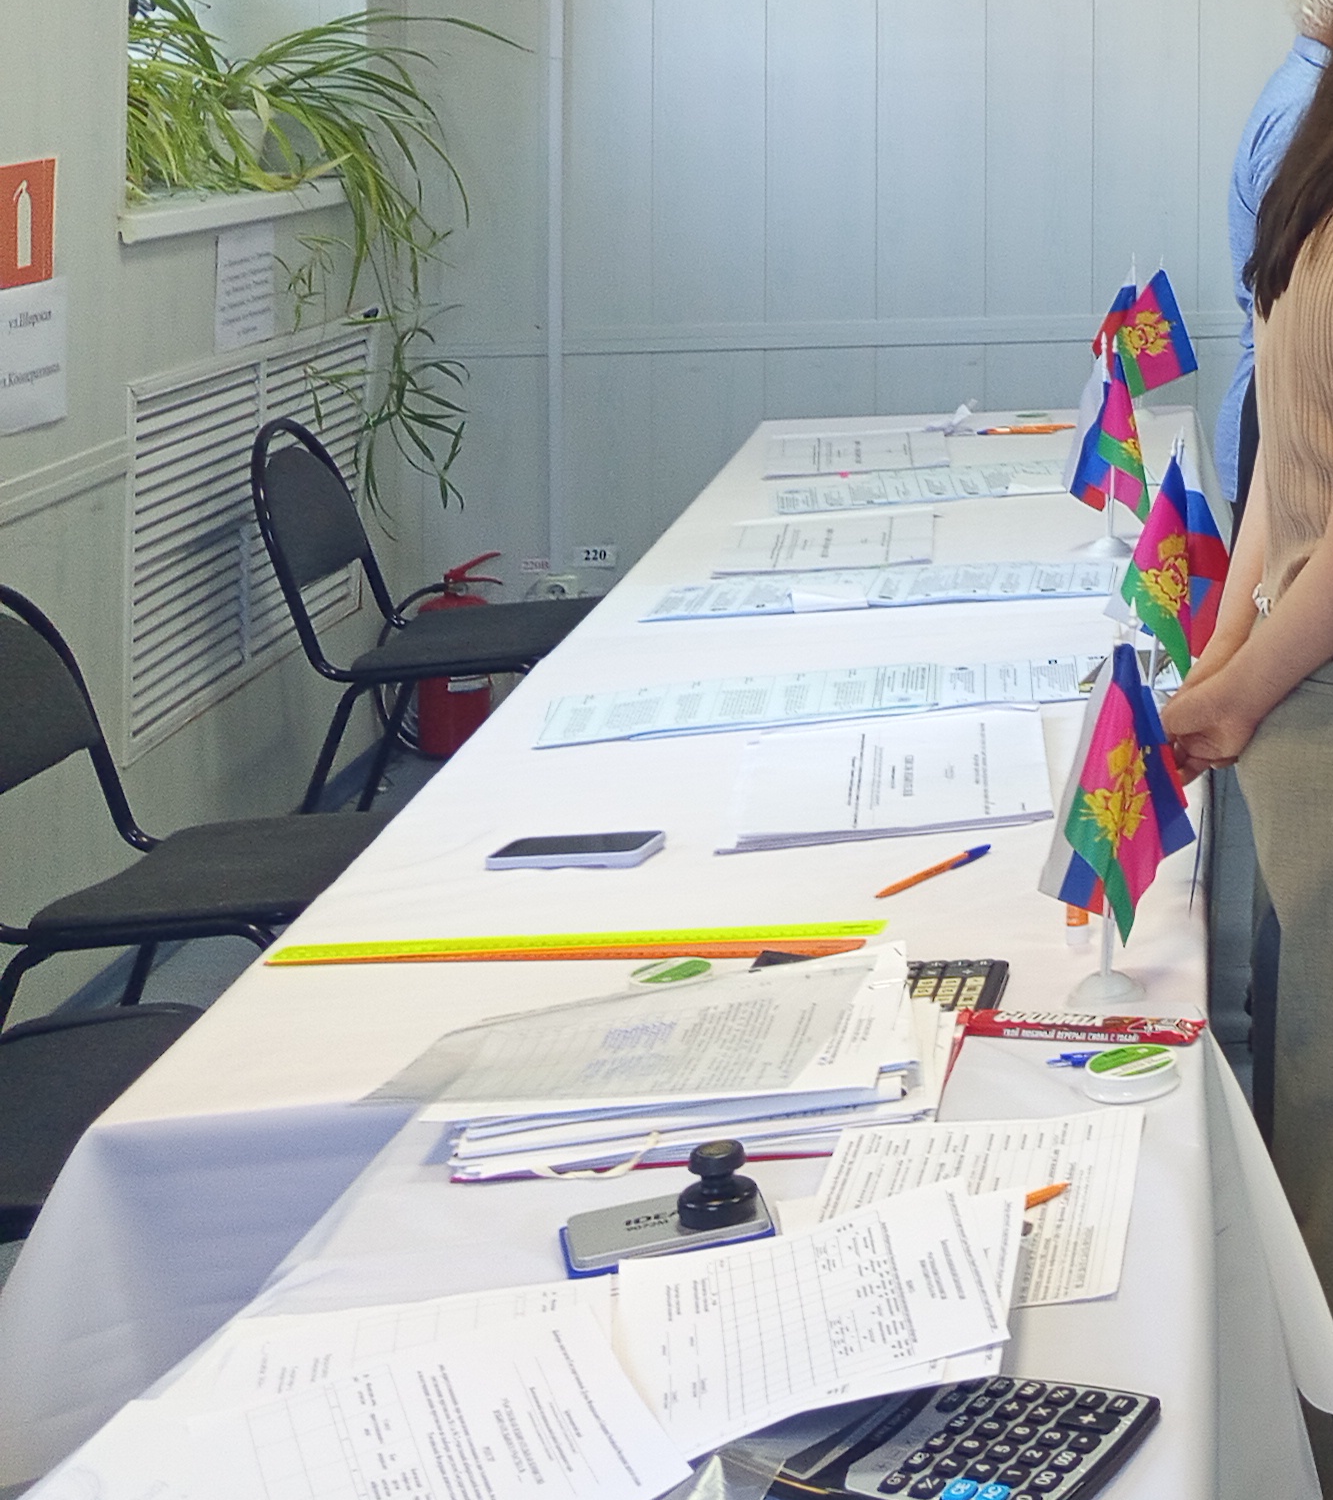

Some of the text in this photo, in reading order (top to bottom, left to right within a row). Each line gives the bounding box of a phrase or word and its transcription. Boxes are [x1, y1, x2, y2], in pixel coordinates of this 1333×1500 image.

[584, 549, 607, 561] 220
[1044, 1431, 1061, 1440] 3
[993, 1444, 1011, 1453] 5
[1025, 1449, 1043, 1458] 2
[941, 1458, 957, 1467] 7
[975, 1463, 991, 1472] 4
[1034, 1470, 1057, 1485] 00
